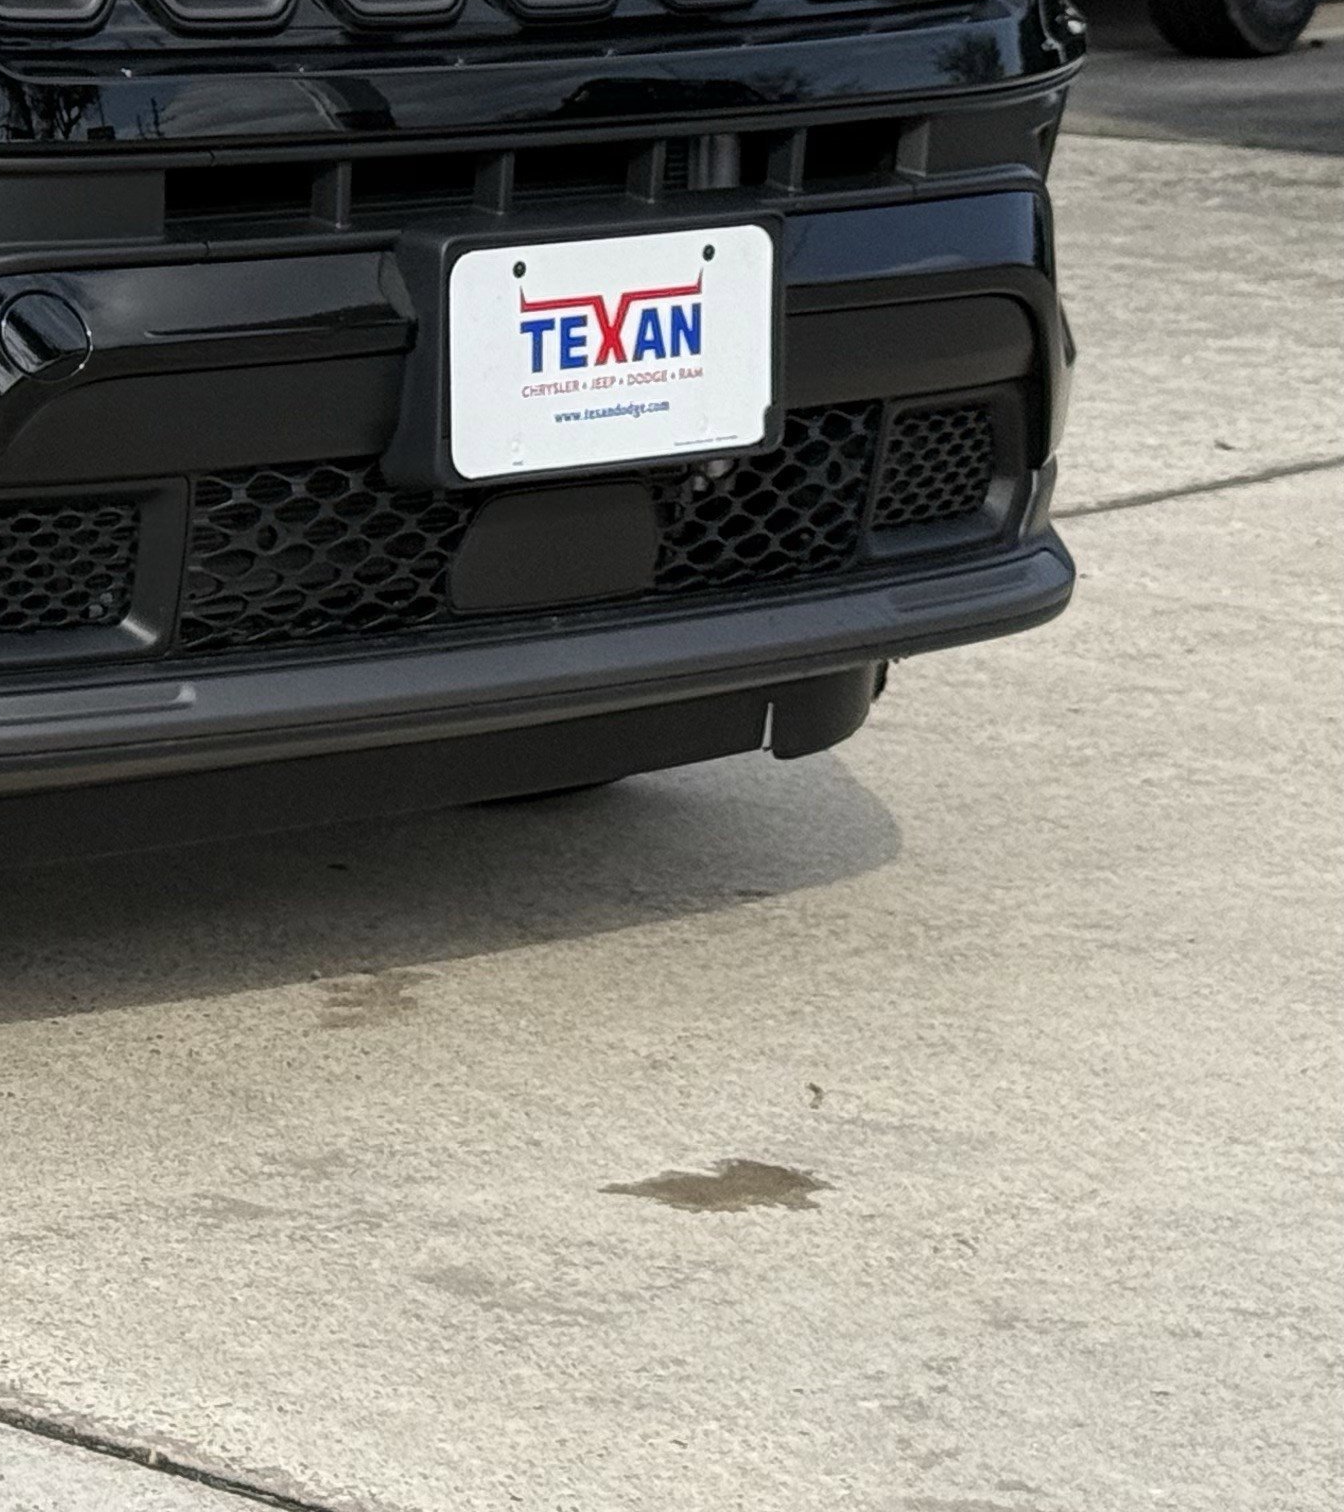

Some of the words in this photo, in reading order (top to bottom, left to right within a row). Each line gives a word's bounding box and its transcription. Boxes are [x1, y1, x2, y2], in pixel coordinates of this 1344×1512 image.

[519, 285, 703, 374] TEXAN
[521, 379, 580, 398] CHRYSLER
[590, 375, 617, 391] JEEP
[626, 369, 668, 386] DODGE
[678, 367, 704, 381] RAM
